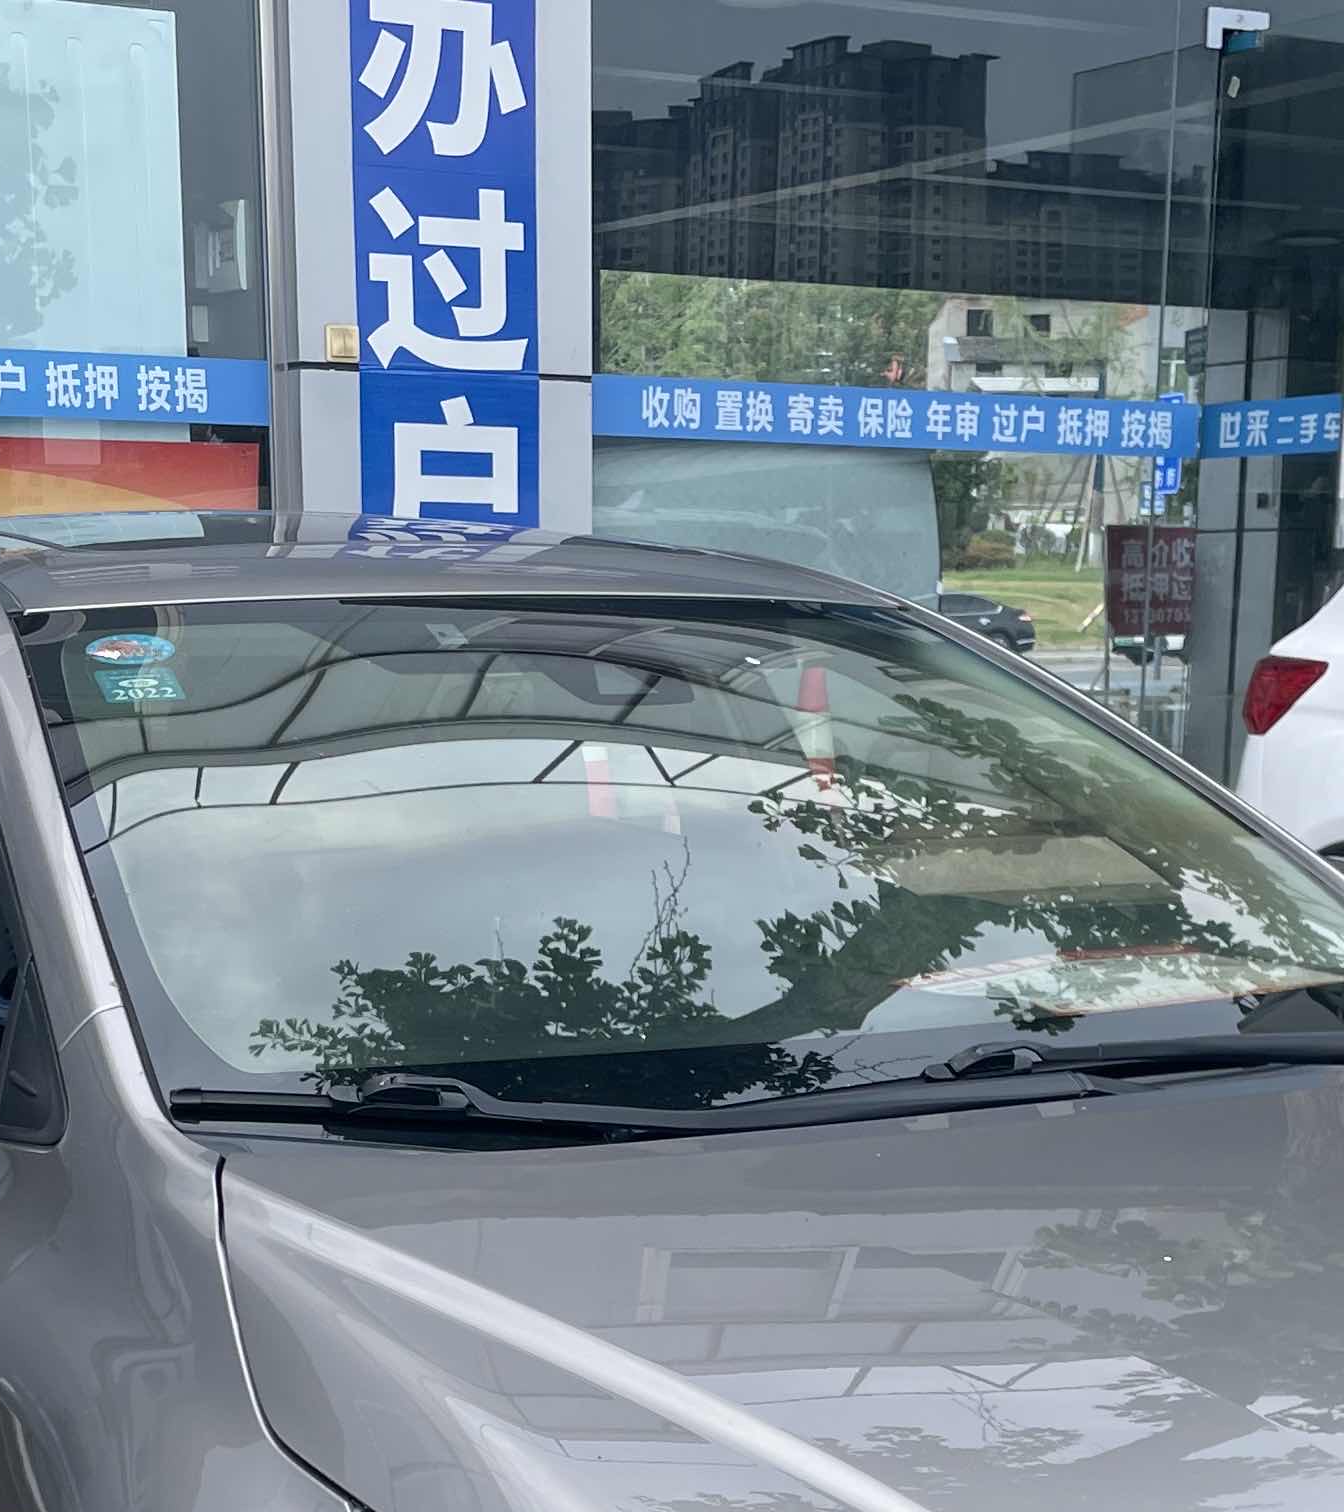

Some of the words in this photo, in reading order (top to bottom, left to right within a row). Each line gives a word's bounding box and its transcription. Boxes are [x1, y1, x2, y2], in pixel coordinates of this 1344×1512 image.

[358, 0, 528, 519] 办过户
[46, 361, 119, 410] 抵押
[137, 365, 208, 413] 按揭
[642, 386, 701, 429] 收购
[715, 391, 774, 432] 置换
[788, 393, 844, 436] 寄卖
[858, 397, 913, 438] 保险
[926, 401, 980, 441] 年审
[992, 404, 1045, 443] 过户
[1058, 406, 1110, 446] 抵押
[1121, 409, 1172, 449] 按揭
[112, 687, 177, 701] 2022
